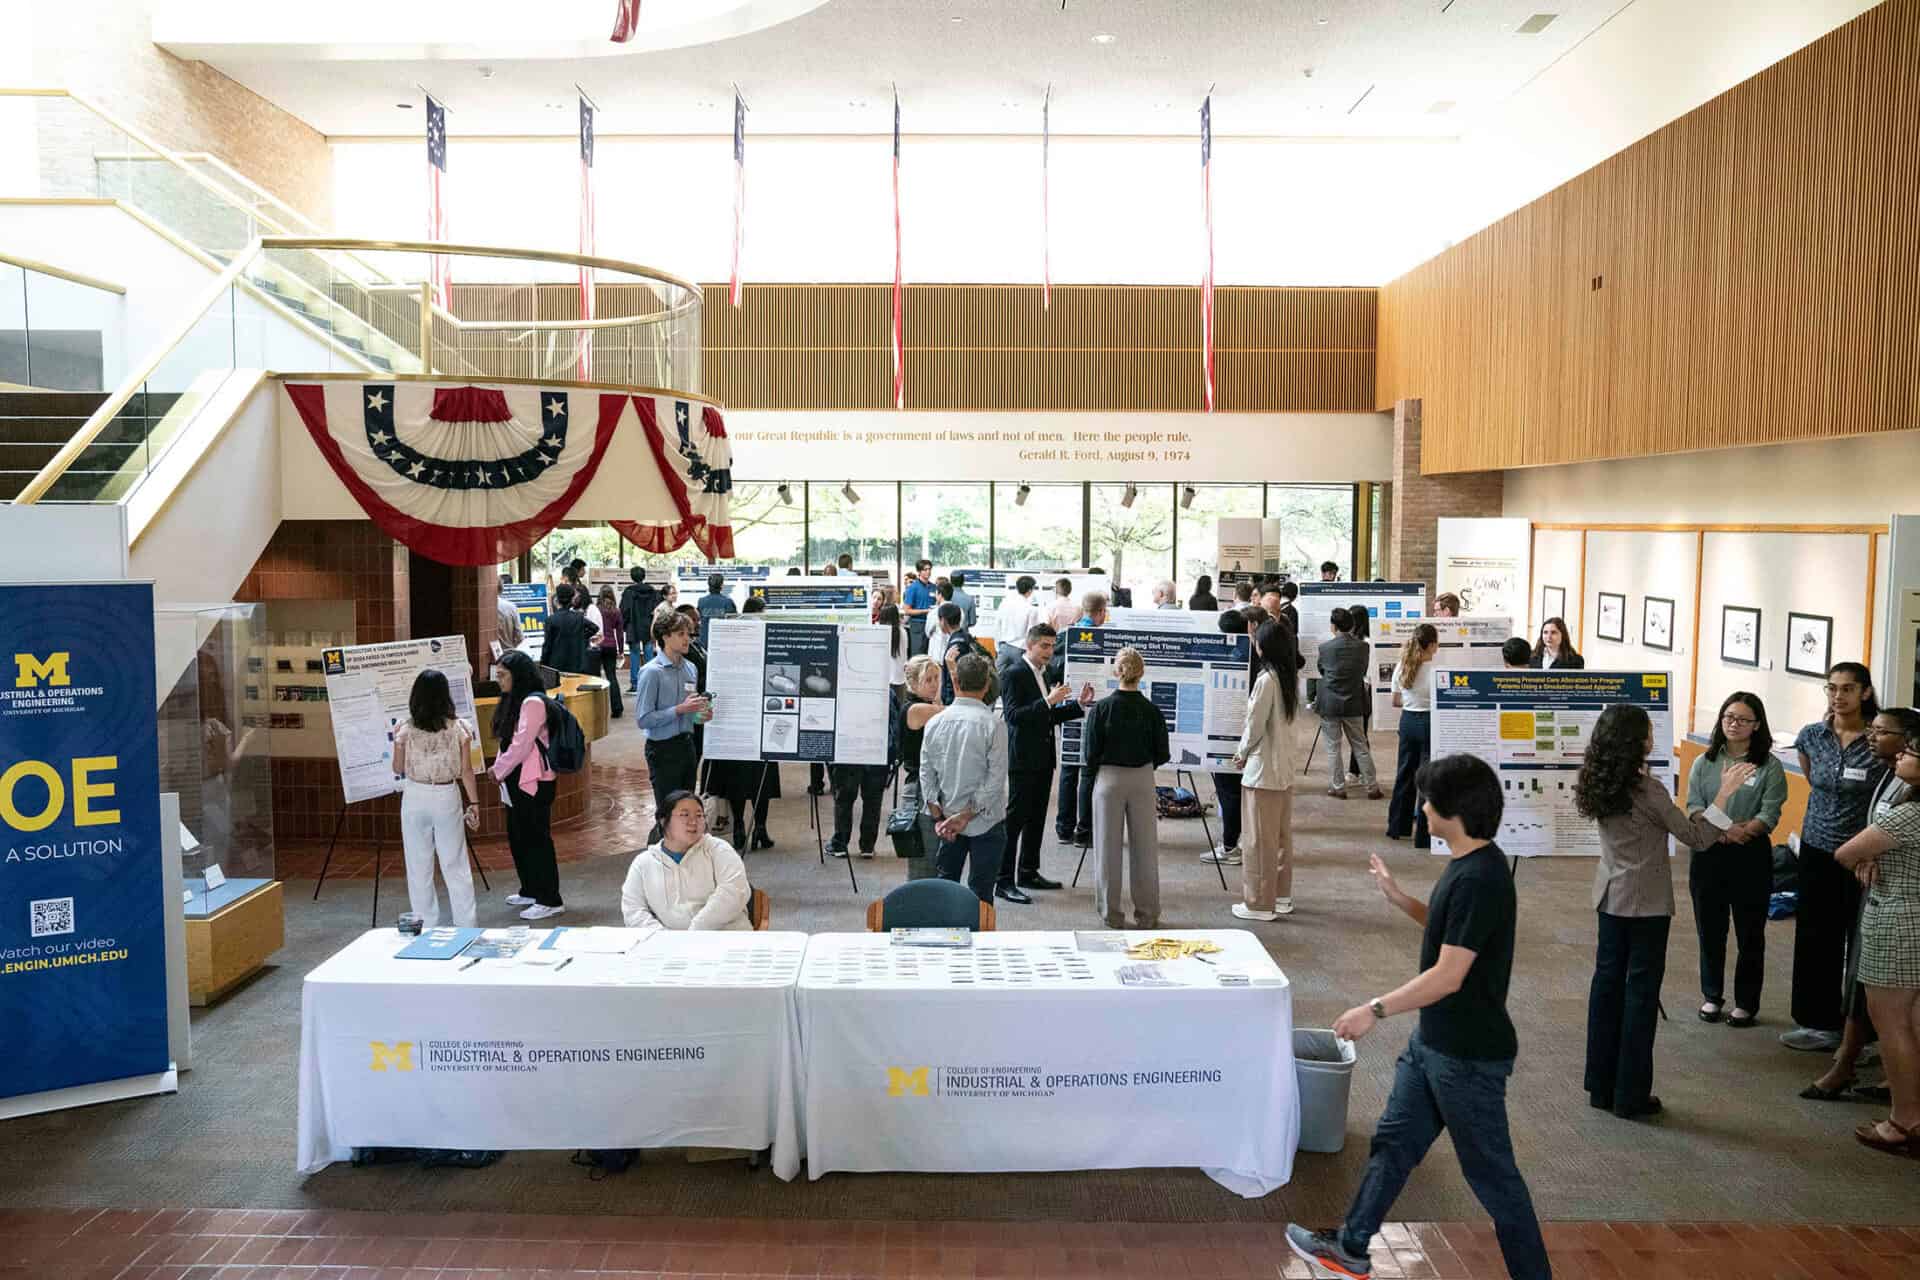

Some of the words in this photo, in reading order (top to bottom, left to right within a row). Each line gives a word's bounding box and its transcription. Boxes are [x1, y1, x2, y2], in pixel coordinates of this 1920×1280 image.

[735, 431, 753, 441] our
[757, 431, 788, 441] Great
[791, 430, 840, 444] Republic
[843, 430, 853, 441] is
[855, 433, 863, 441] a
[865, 431, 932, 443] government
[935, 430, 947, 441] of
[949, 430, 975, 441] laws
[977, 430, 999, 441] and
[1002, 431, 1021, 441] not
[1024, 430, 1036, 441] of
[1038, 432, 1065, 441] men.
[1073, 431, 1101, 442] Here
[1103, 431, 1121, 442] the
[1124, 431, 1164, 445] people
[1166, 431, 1192, 442] rule.
[1019, 449, 1056, 461] Gerald
[1059, 450, 1070, 461] R.
[1074, 450, 1104, 461] Ford,
[1107, 450, 1145, 463] August
[1148, 450, 1158, 462] 9,
[1163, 450, 1191, 461] 1974
[15, 652, 71, 687] M
[38, 690, 46, 698] &
[47, 686, 104, 697] OPERATIONS
[12, 697, 75, 708] ENGINEERING
[6, 848, 21, 863] A
[24, 839, 122, 861] SOLUTION
[45, 943, 71, 954] our
[75, 936, 116, 951] video
[429, 1040, 460, 1049] COLLEGE
[463, 1040, 471, 1049] OF
[473, 1039, 524, 1048] ENGINEERING
[368, 1041, 416, 1073] M
[430, 1050, 507, 1063] INDUSTRIAL
[512, 1049, 522, 1063] &
[528, 1049, 611, 1064] OPERATIONS
[615, 1046, 705, 1062] ENGINEERING
[431, 1064, 480, 1072] UNIVERSITY
[482, 1064, 493, 1072] OF
[494, 1064, 538, 1073] MICHIGAN
[946, 1066, 978, 1075] COLLEGE
[980, 1066, 989, 1074] OF
[991, 1066, 1042, 1074] ENGINEERING
[886, 1066, 929, 1097] M
[946, 1075, 1025, 1089] INDUSTRIAL
[1030, 1075, 1041, 1089] &
[1046, 1073, 1128, 1088] OPERATIONS
[1133, 1070, 1222, 1086] ENGINEERING
